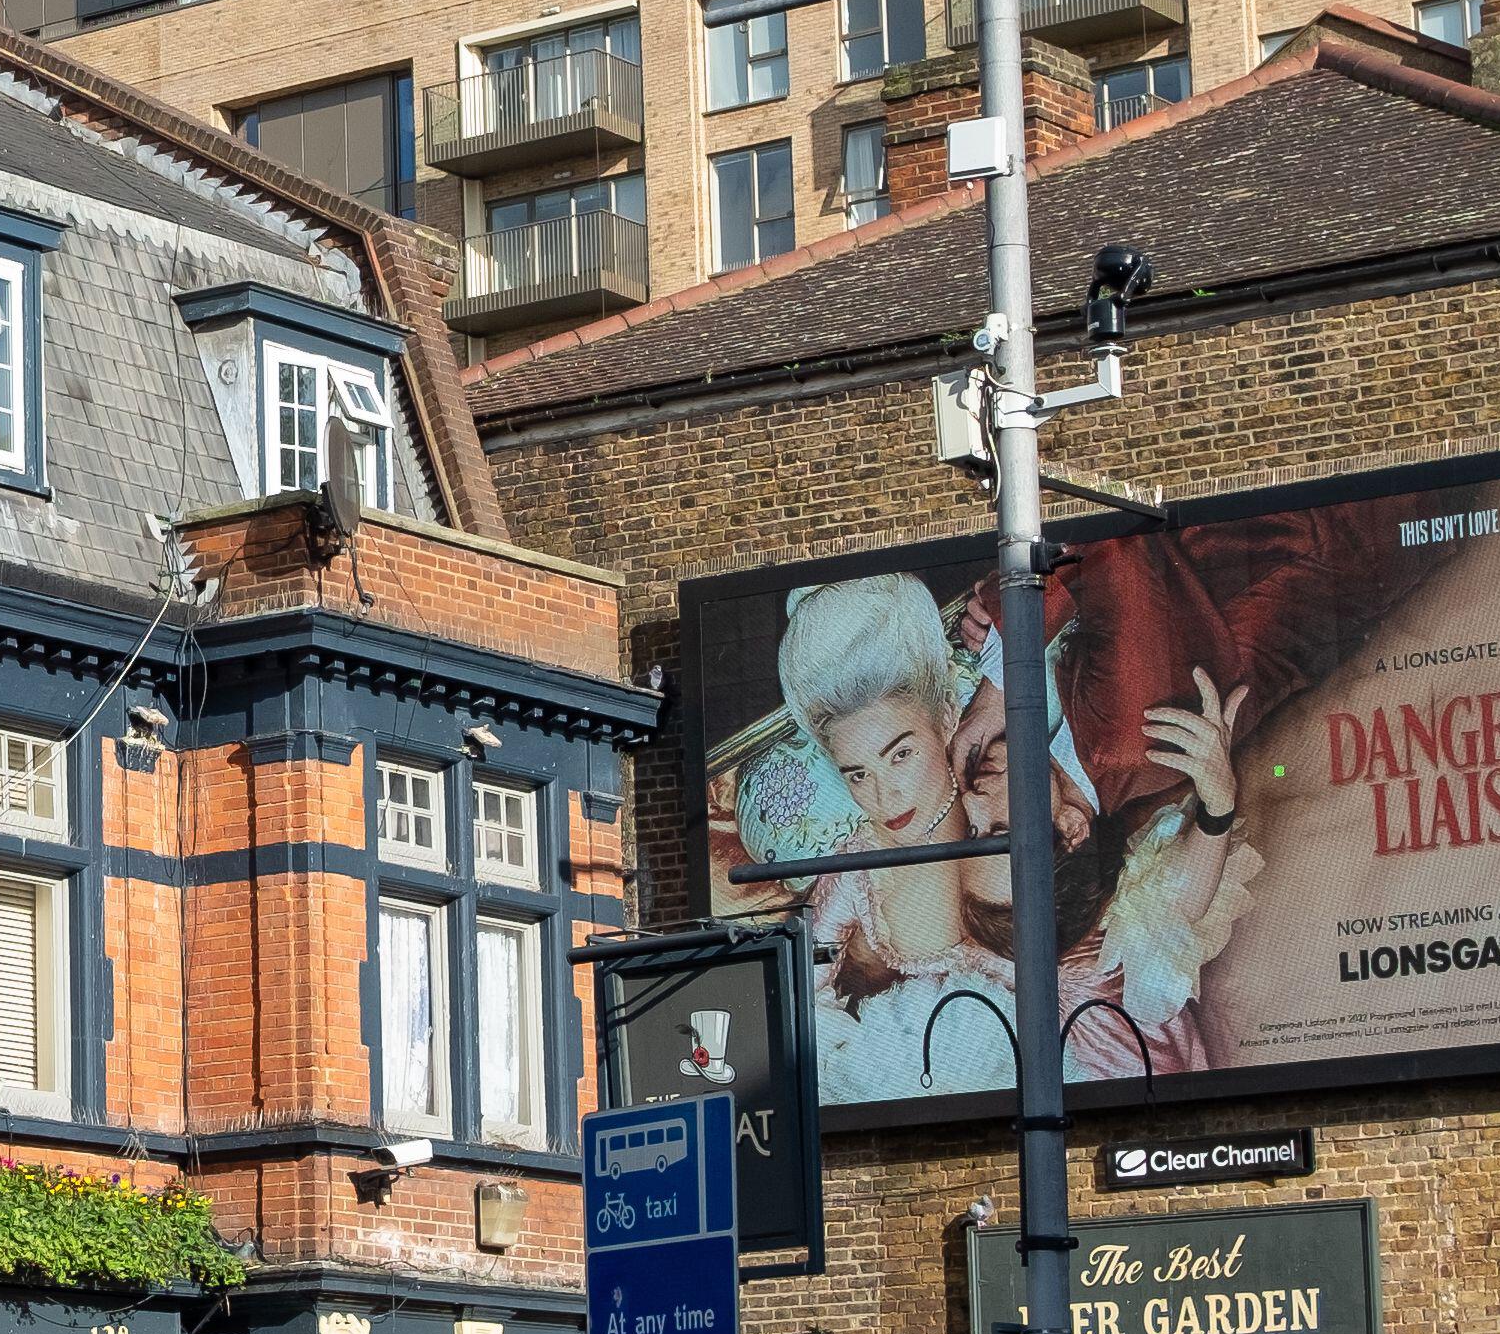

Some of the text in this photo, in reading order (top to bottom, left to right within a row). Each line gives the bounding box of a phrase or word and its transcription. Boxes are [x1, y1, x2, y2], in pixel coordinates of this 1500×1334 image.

[1399, 520, 1428, 546] THIS
[1431, 514, 1464, 542] ISN'T
[1375, 657, 1387, 673] A
[1337, 916, 1383, 937] NOW
[1388, 905, 1493, 931] STREAMING
[1150, 1139, 1295, 1174] Clear Channel
[645, 1192, 677, 1220] taxi
[1080, 1234, 1245, 1287] The Best
[674, 1305, 715, 1333] time
